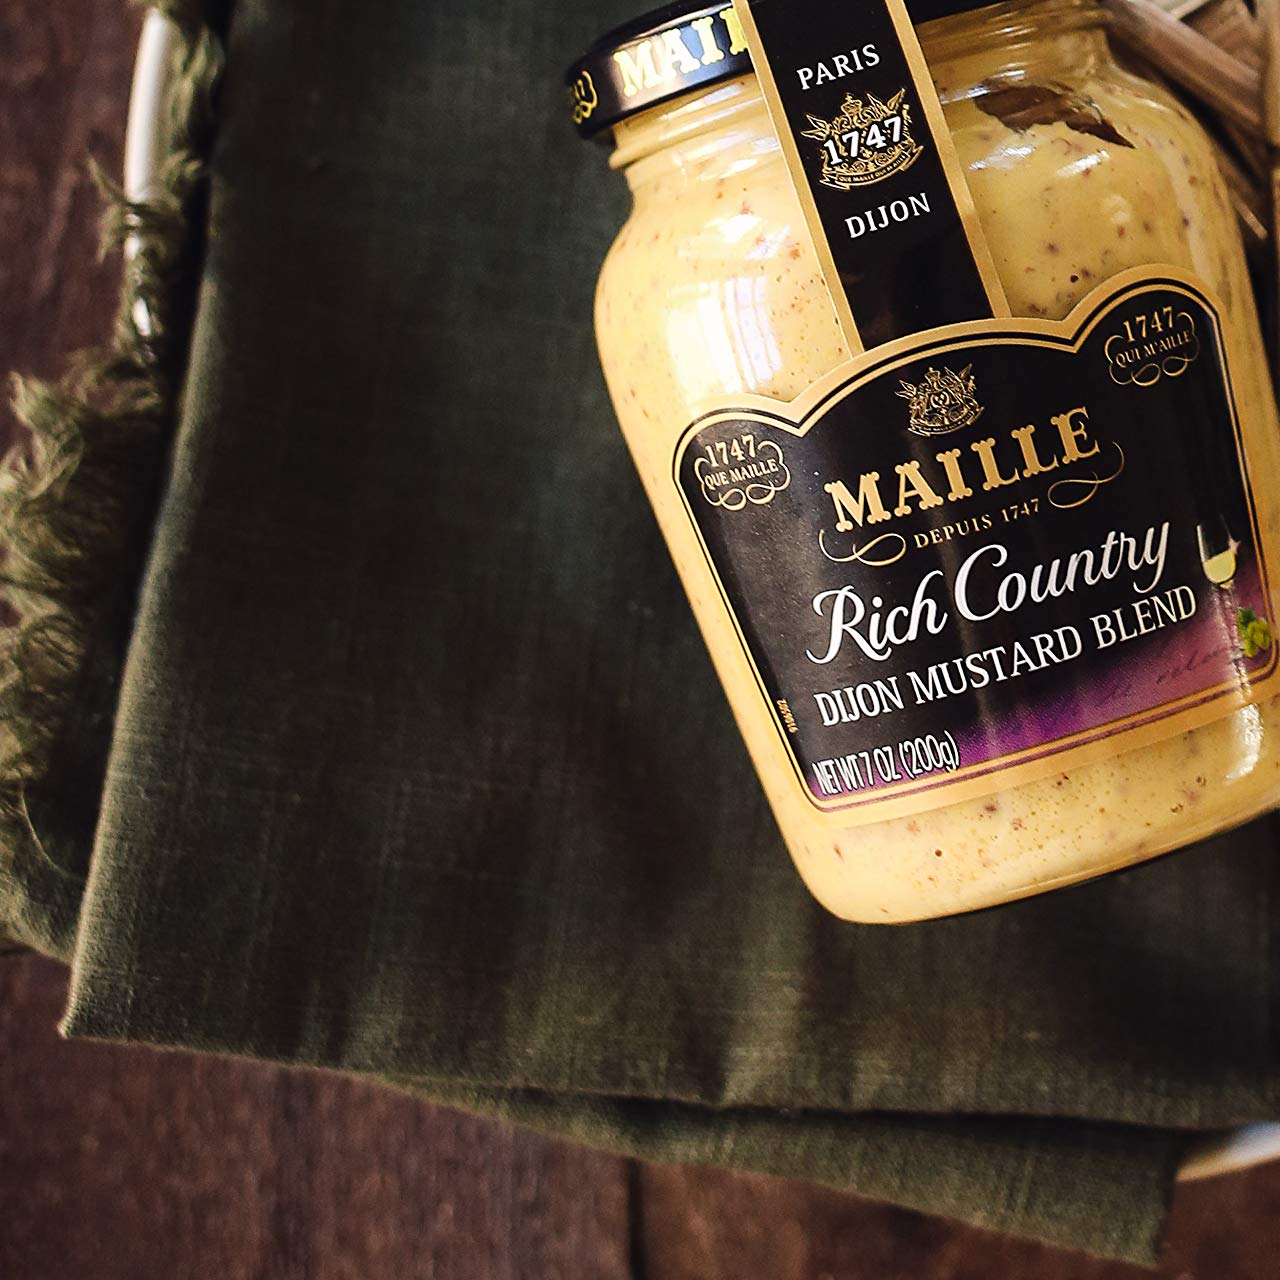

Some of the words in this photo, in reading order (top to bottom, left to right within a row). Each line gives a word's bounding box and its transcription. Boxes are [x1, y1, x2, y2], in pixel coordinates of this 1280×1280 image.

[796, 44, 880, 90] PARIS
[824, 116, 901, 165] 1747
[845, 192, 931, 239] DIJON
[1123, 306, 1172, 342] 1747
[1116, 348, 1140, 368] QUI
[704, 471, 730, 491] QUE
[728, 458, 779, 483] MAILLE
[705, 434, 756, 467] 1747
[824, 406, 1100, 532] MAILLE
[914, 514, 993, 549] DEPUIS
[1001, 498, 1041, 523] 1747
[805, 570, 948, 665] Rich
[954, 522, 1170, 621] Country
[813, 676, 904, 727] DIJON
[906, 625, 1083, 705] MUSTARD
[1089, 585, 1197, 650] BLEND
[811, 758, 843, 795] NET
[834, 754, 865, 791] WT
[858, 751, 875, 786] 7
[873, 745, 902, 782] OZ
[898, 730, 960, 779] (200g)
